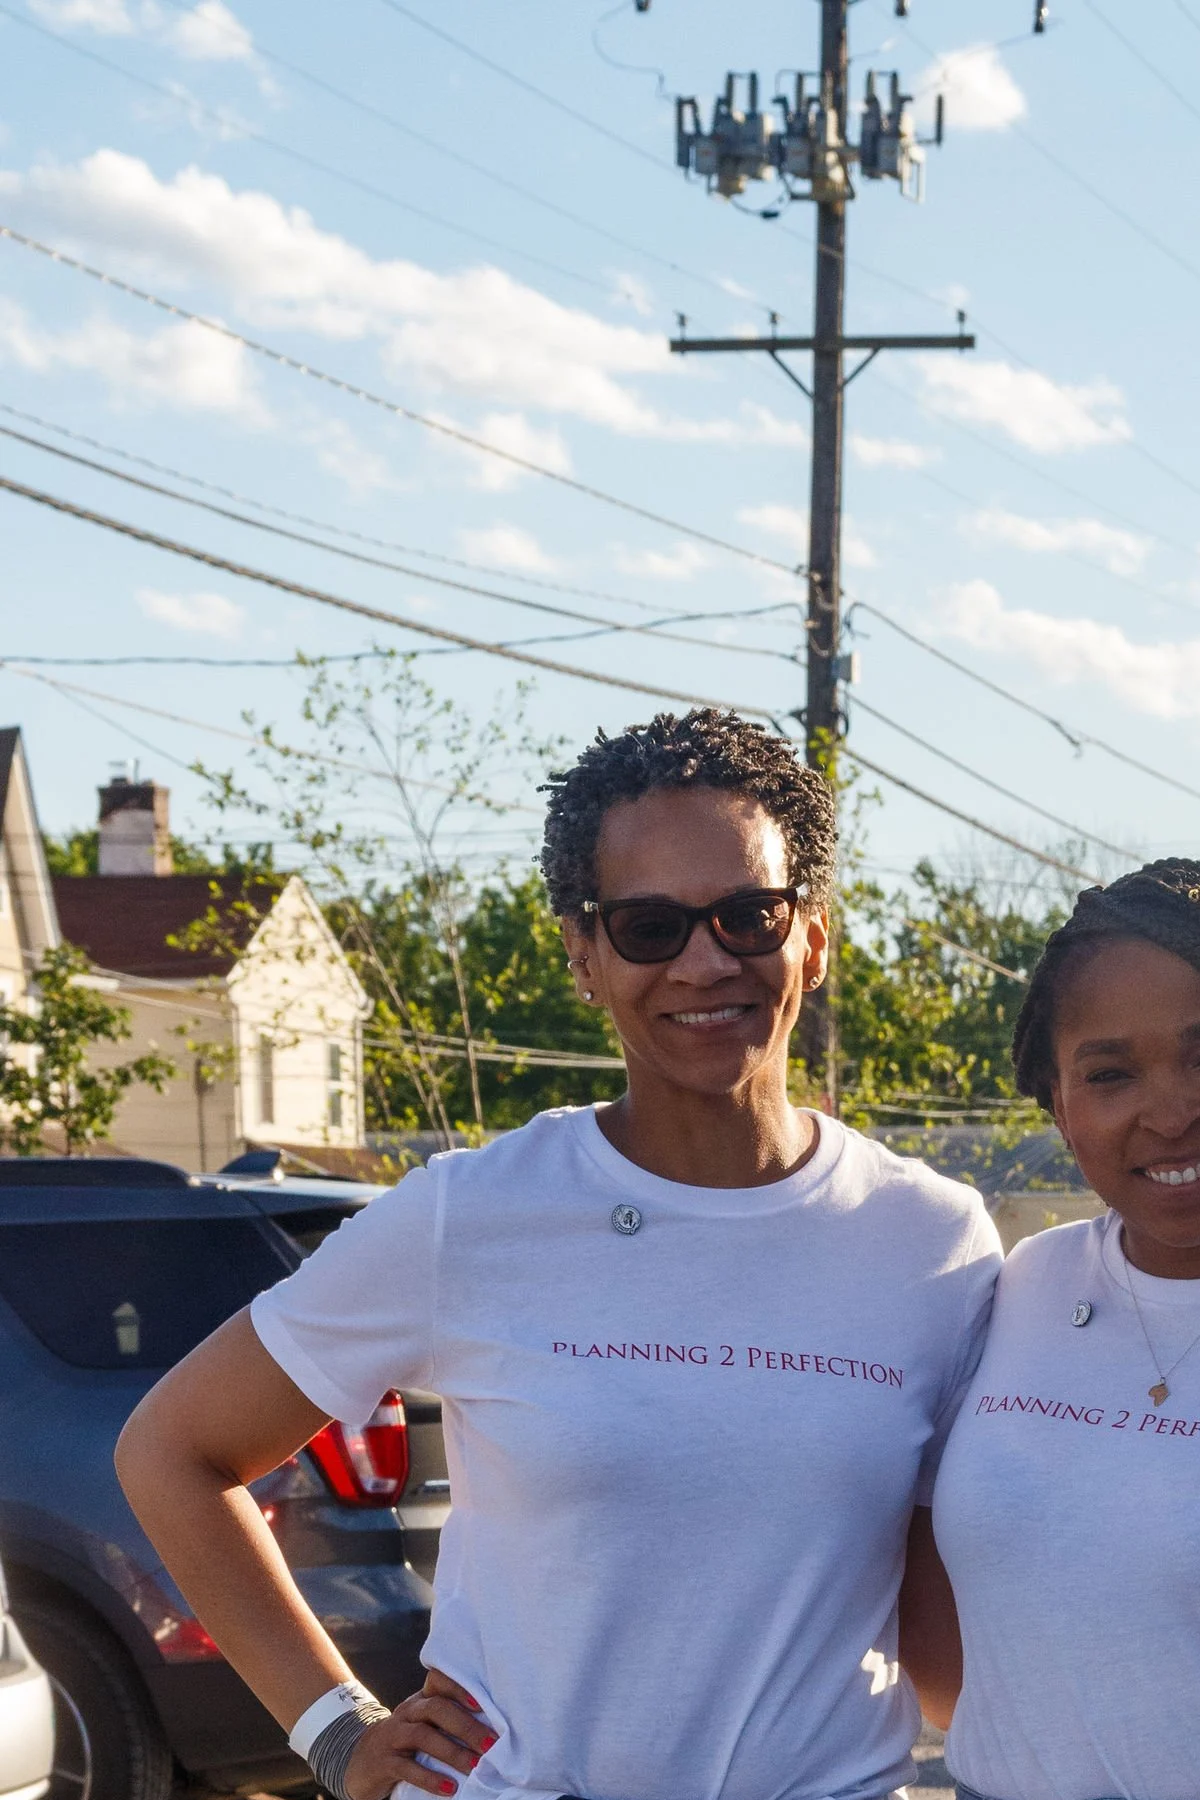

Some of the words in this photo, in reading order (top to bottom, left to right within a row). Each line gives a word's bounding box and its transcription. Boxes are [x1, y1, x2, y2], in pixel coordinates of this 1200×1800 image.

[551, 1341, 708, 1365] PLANNING
[719, 1345, 735, 1366] 2
[746, 1346, 904, 1389] PERFECTION
[974, 1395, 1105, 1425] PLANNING
[1111, 1409, 1131, 1429] 2
